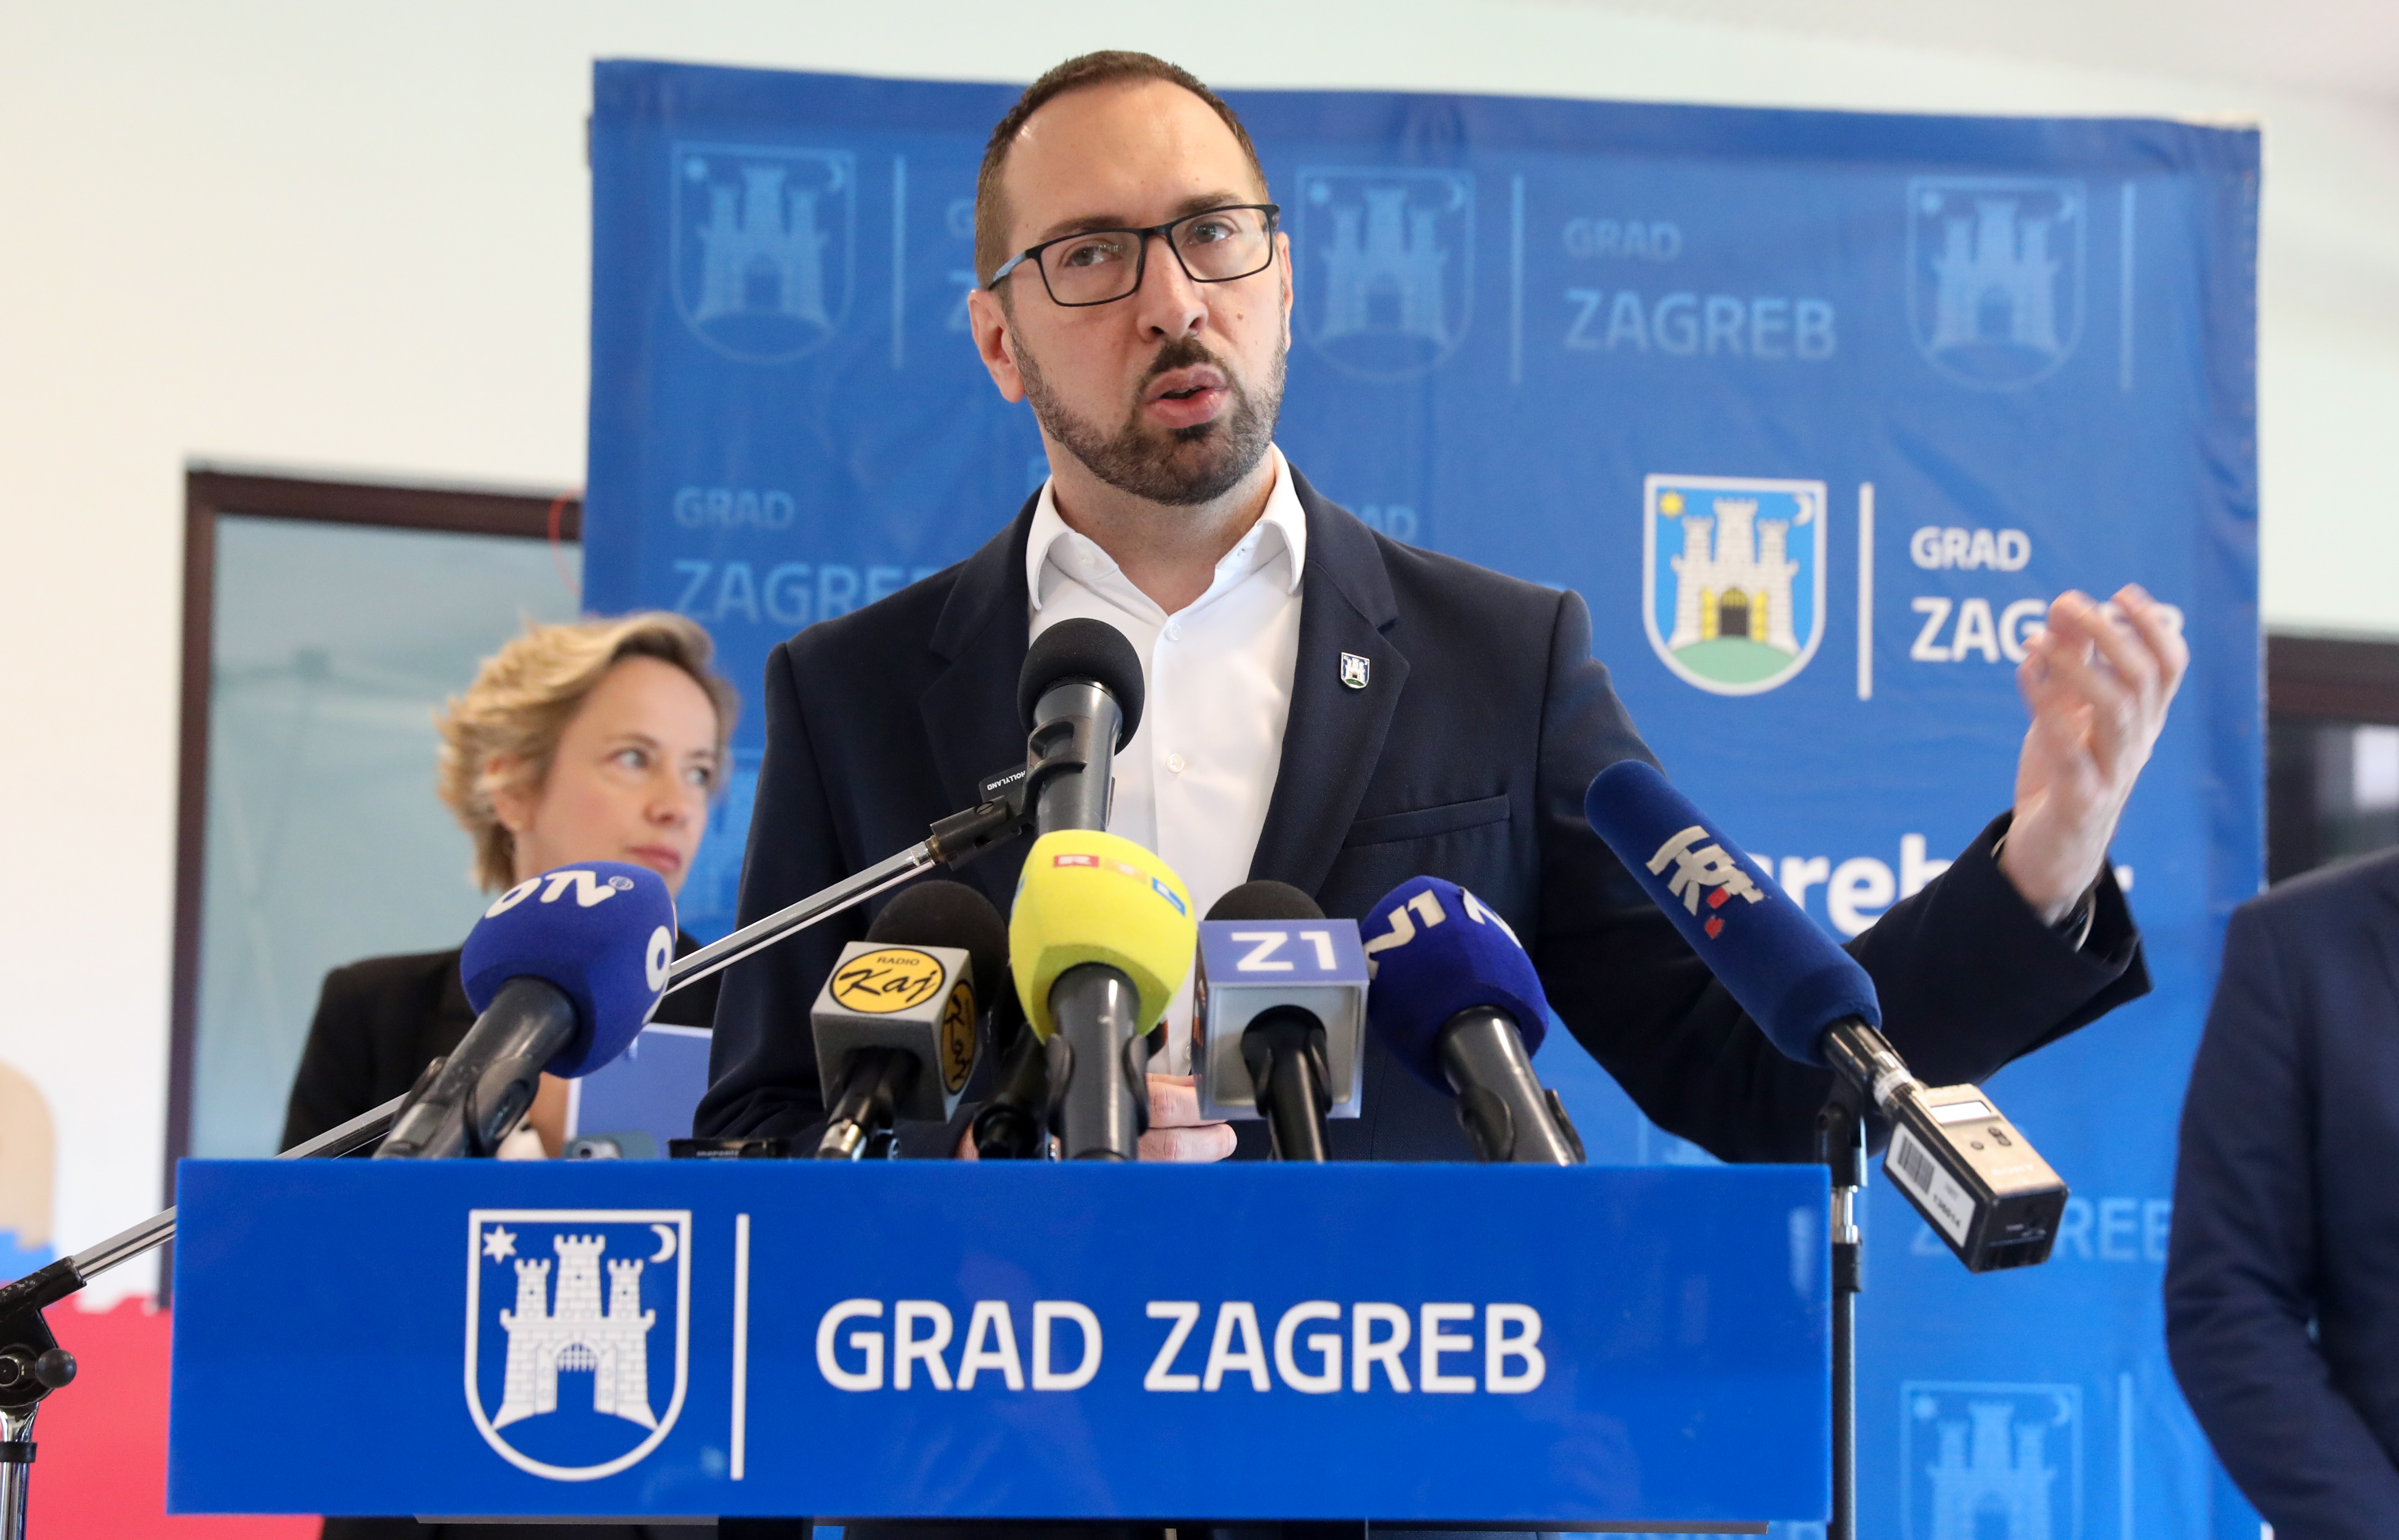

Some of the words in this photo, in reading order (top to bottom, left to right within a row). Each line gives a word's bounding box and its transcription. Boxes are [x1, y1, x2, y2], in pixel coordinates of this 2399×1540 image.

[1563, 219, 1682, 262] GRAD
[1565, 289, 1837, 361] ZAGREB
[673, 486, 795, 530] GRAD
[1910, 526, 2032, 572] GRAD
[987, 770, 1025, 791] HOLLYLAND
[485, 870, 617, 919] OTV
[877, 956, 921, 966] RADIO
[1231, 930, 1337, 972] Z1
[838, 968, 938, 1003] Kaj
[815, 1298, 1103, 1392] GRAD
[1143, 1301, 1547, 1394] ZAGREB
